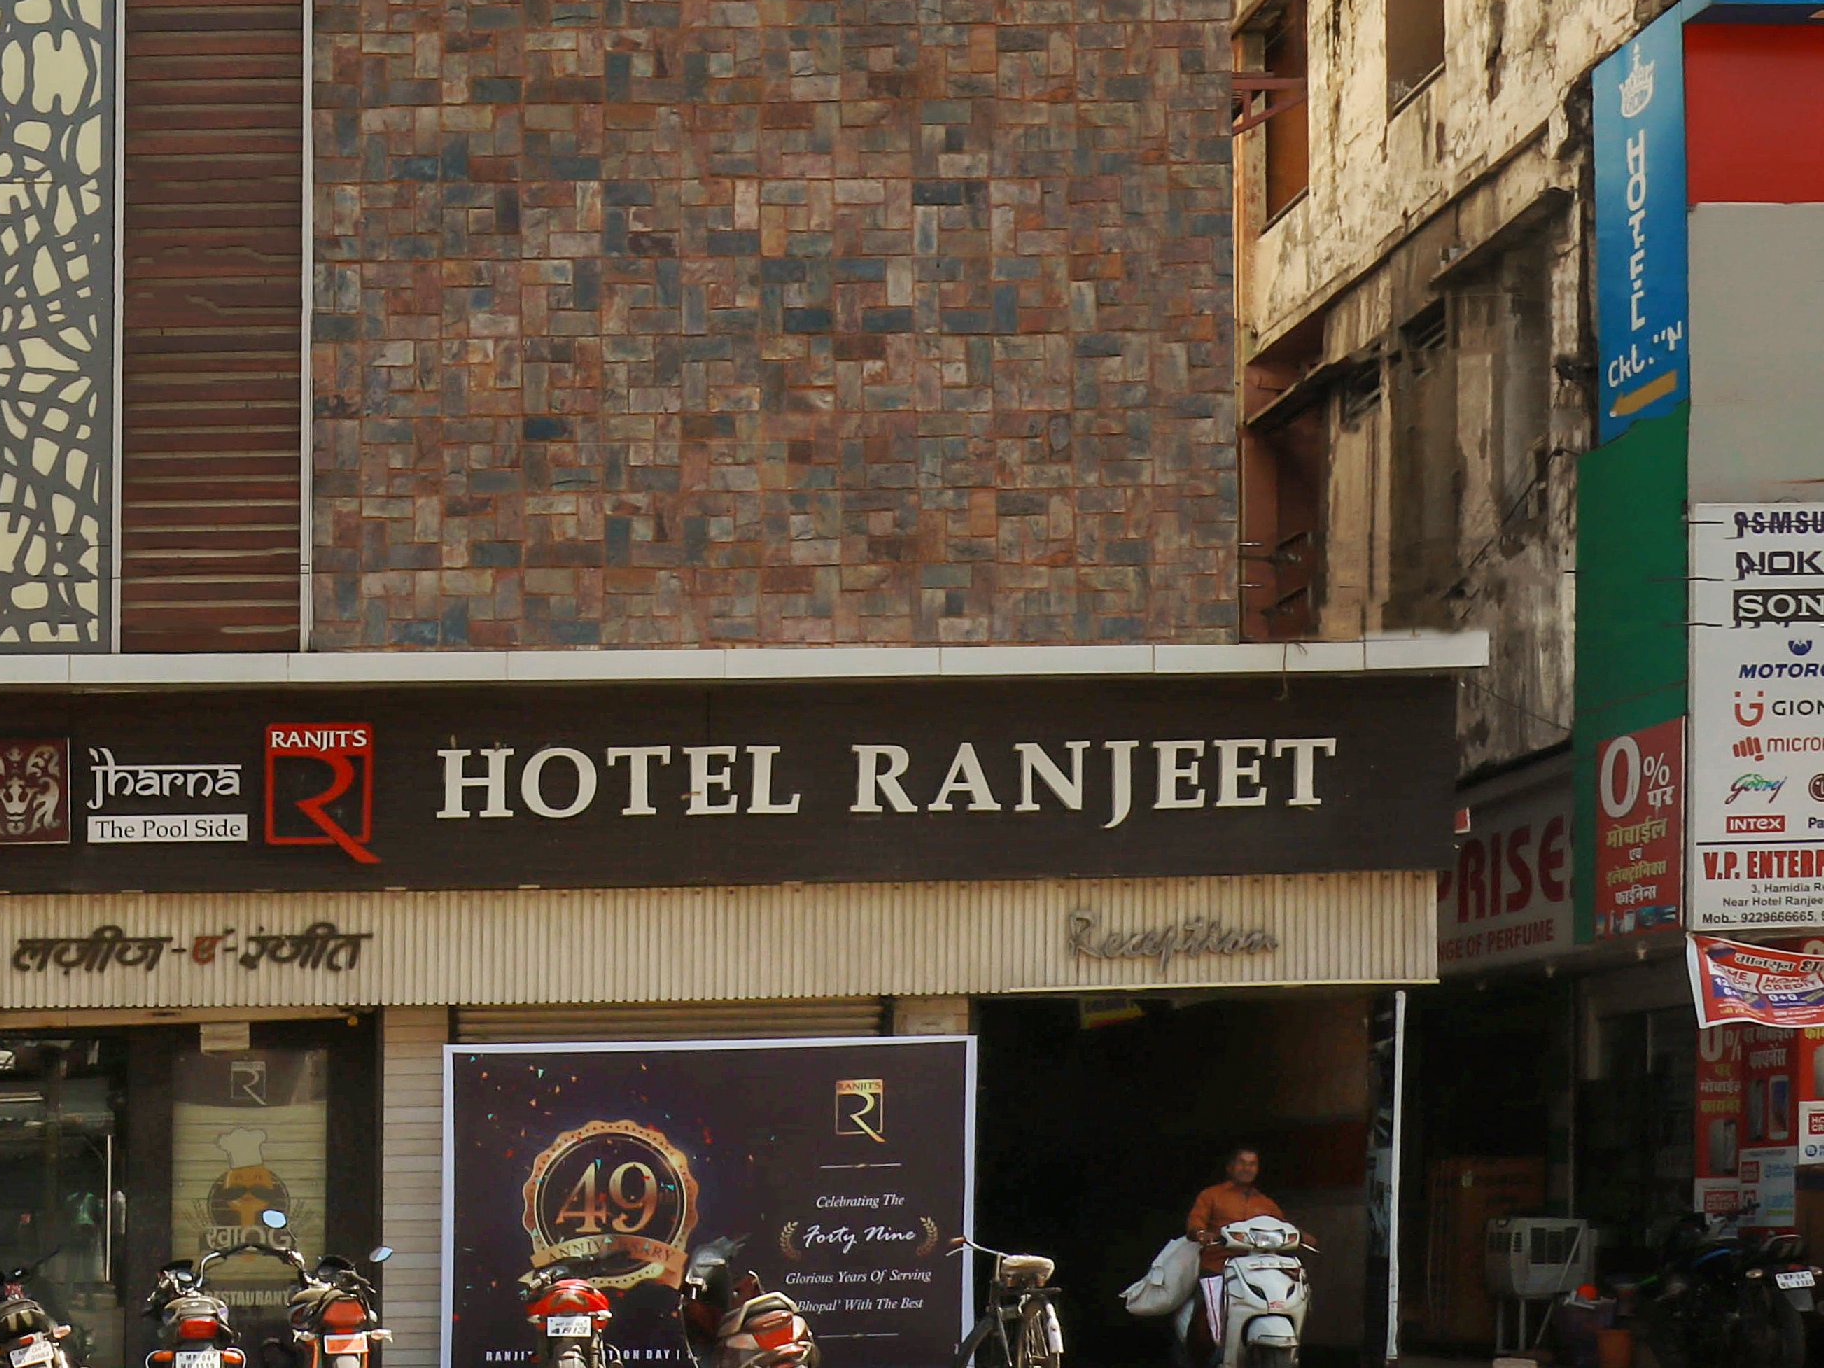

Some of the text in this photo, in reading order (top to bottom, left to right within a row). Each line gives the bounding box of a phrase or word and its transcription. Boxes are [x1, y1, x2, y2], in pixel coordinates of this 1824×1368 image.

[1738, 663, 1824, 679] MOTOR
[271, 729, 368, 749] RANJIT'S
[1767, 736, 1824, 753] micro
[87, 747, 242, 810] jharna
[436, 737, 1336, 828] HOTEL RANJEET
[95, 819, 241, 840] The Pool Side
[1702, 851, 1740, 880] V.P.
[1764, 882, 1810, 893] Hamidia
[1723, 897, 1749, 907] Near
[1752, 896, 1782, 906] Hotel
[1067, 909, 1278, 973] Reception
[1467, 934, 1481, 958] OF
[1486, 918, 1554, 955] PERFUME
[556, 1162, 660, 1233] 49
[816, 1194, 905, 1209] Celebrating The
[802, 1224, 916, 1254] Forty Nine
[785, 1268, 932, 1284] Glorious Years Of Serving
[845, 1298, 873, 1311] With
[876, 1297, 898, 1310] The
[900, 1297, 924, 1310] Best
[646, 1348, 670, 1361] DAY
